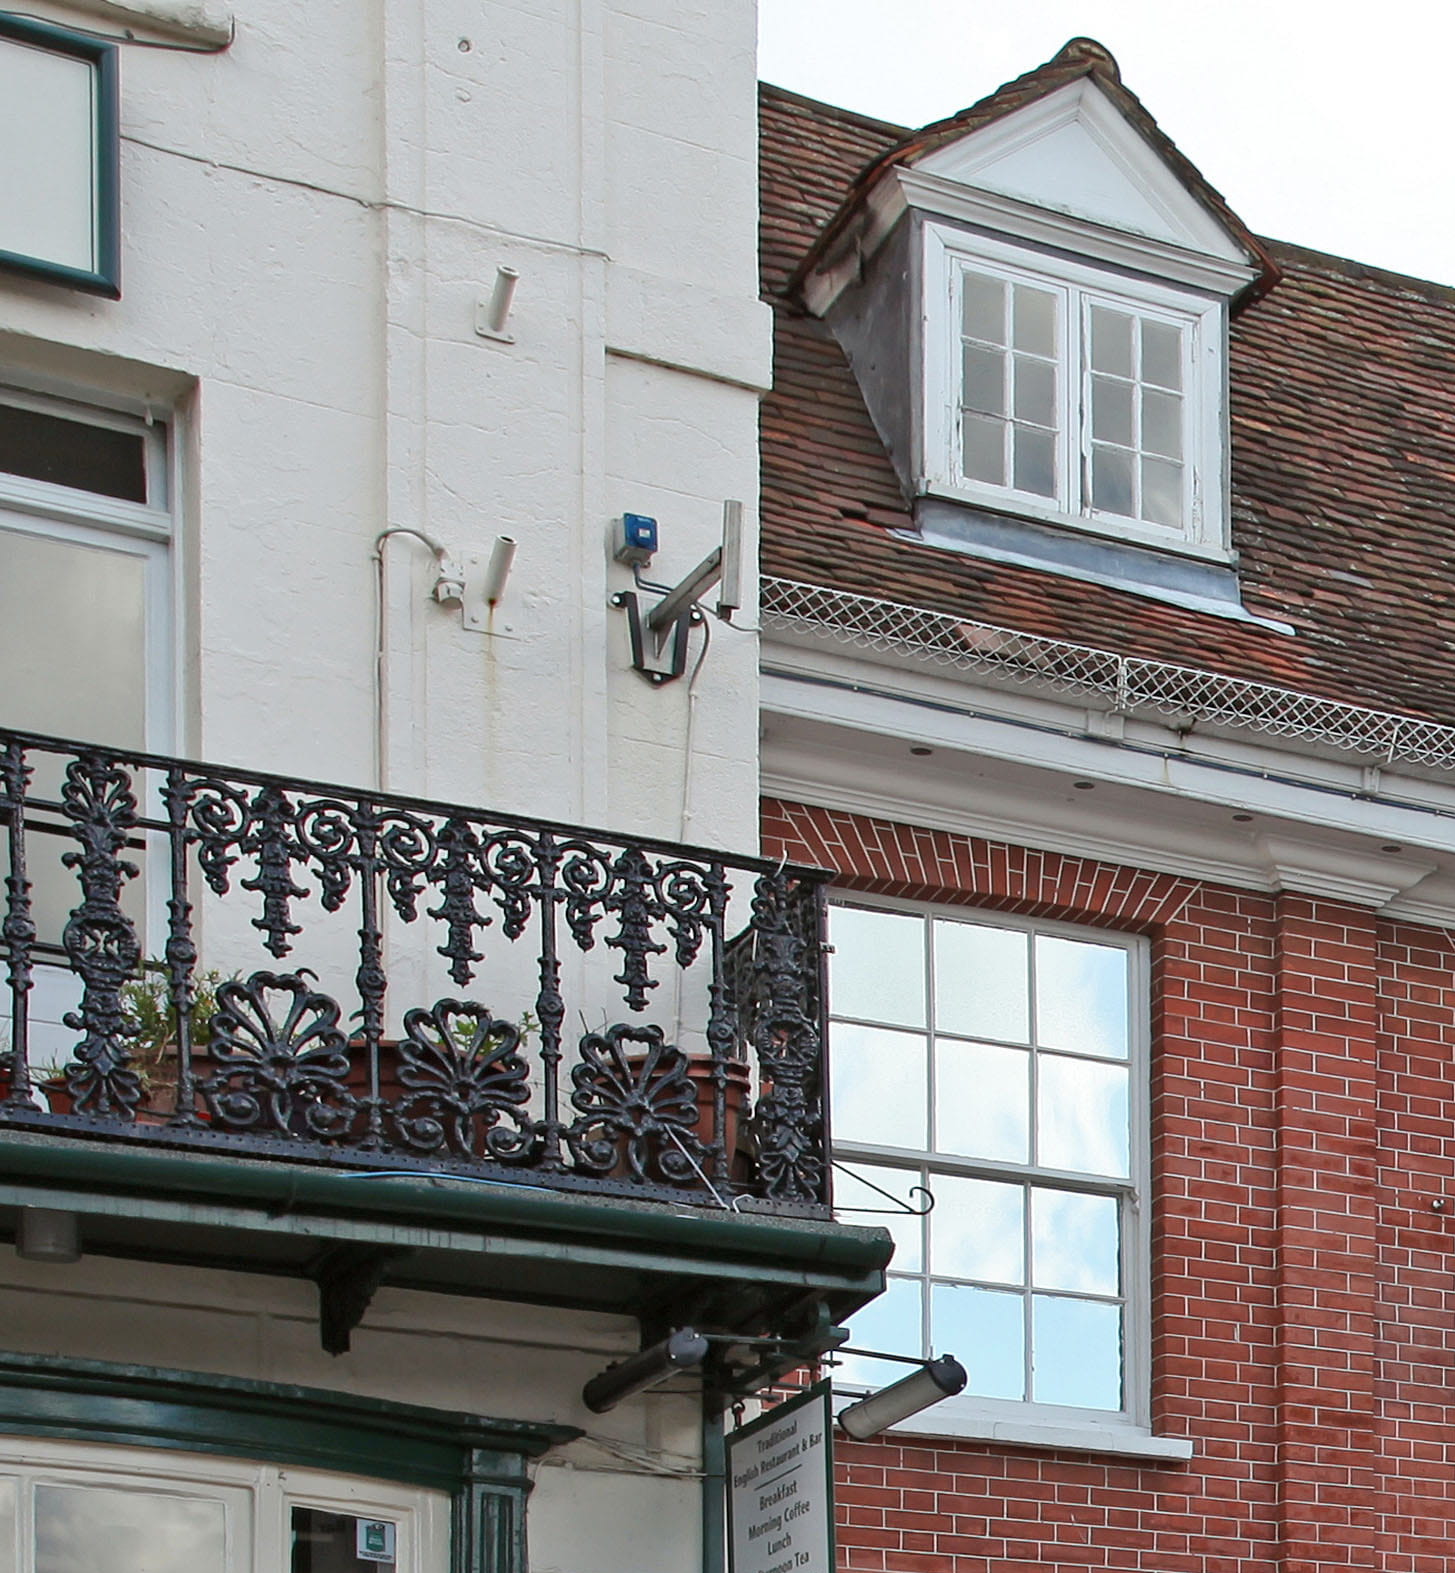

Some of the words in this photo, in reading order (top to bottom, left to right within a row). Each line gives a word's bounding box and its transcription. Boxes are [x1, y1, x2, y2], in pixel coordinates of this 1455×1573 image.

[757, 1420, 797, 1453] Traditional
[734, 1465, 759, 1488] English
[760, 1443, 800, 1473] Restaurant
[802, 1438, 808, 1451] &
[809, 1432, 822, 1448] Bar
[760, 1480, 797, 1511] Breakfast
[749, 1515, 782, 1540] Morning
[784, 1501, 810, 1522] Coffee
[768, 1532, 792, 1555] Lunch
[794, 1552, 809, 1567] Tea
